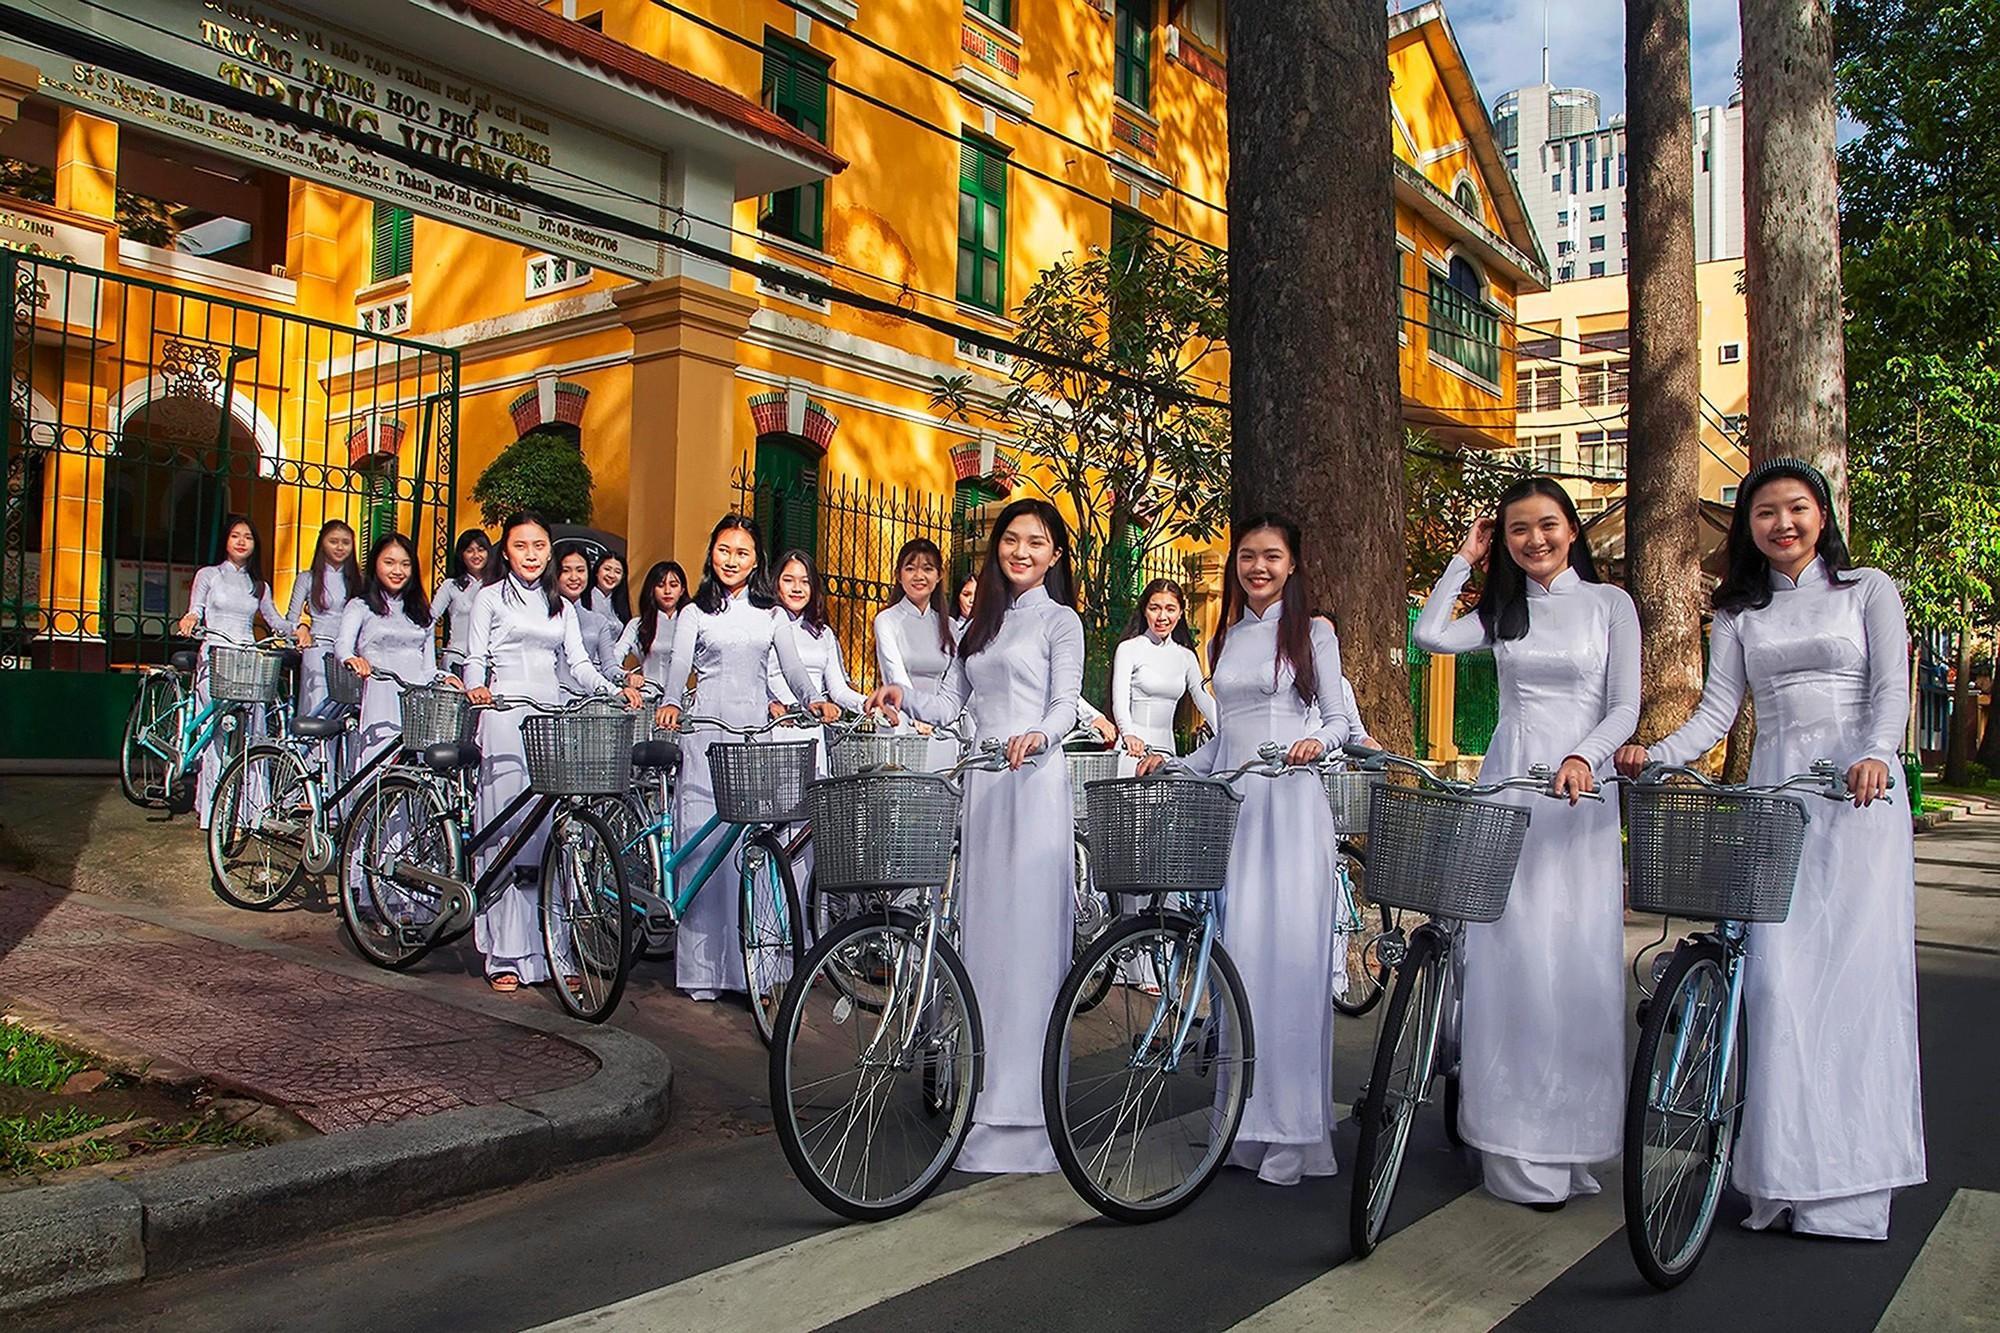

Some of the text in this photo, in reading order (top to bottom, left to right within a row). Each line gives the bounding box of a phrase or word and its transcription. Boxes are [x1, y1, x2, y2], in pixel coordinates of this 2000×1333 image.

[302, 57, 377, 104] TRUNG
[385, 88, 431, 123] HỌC
[438, 109, 480, 139] PHỔ
